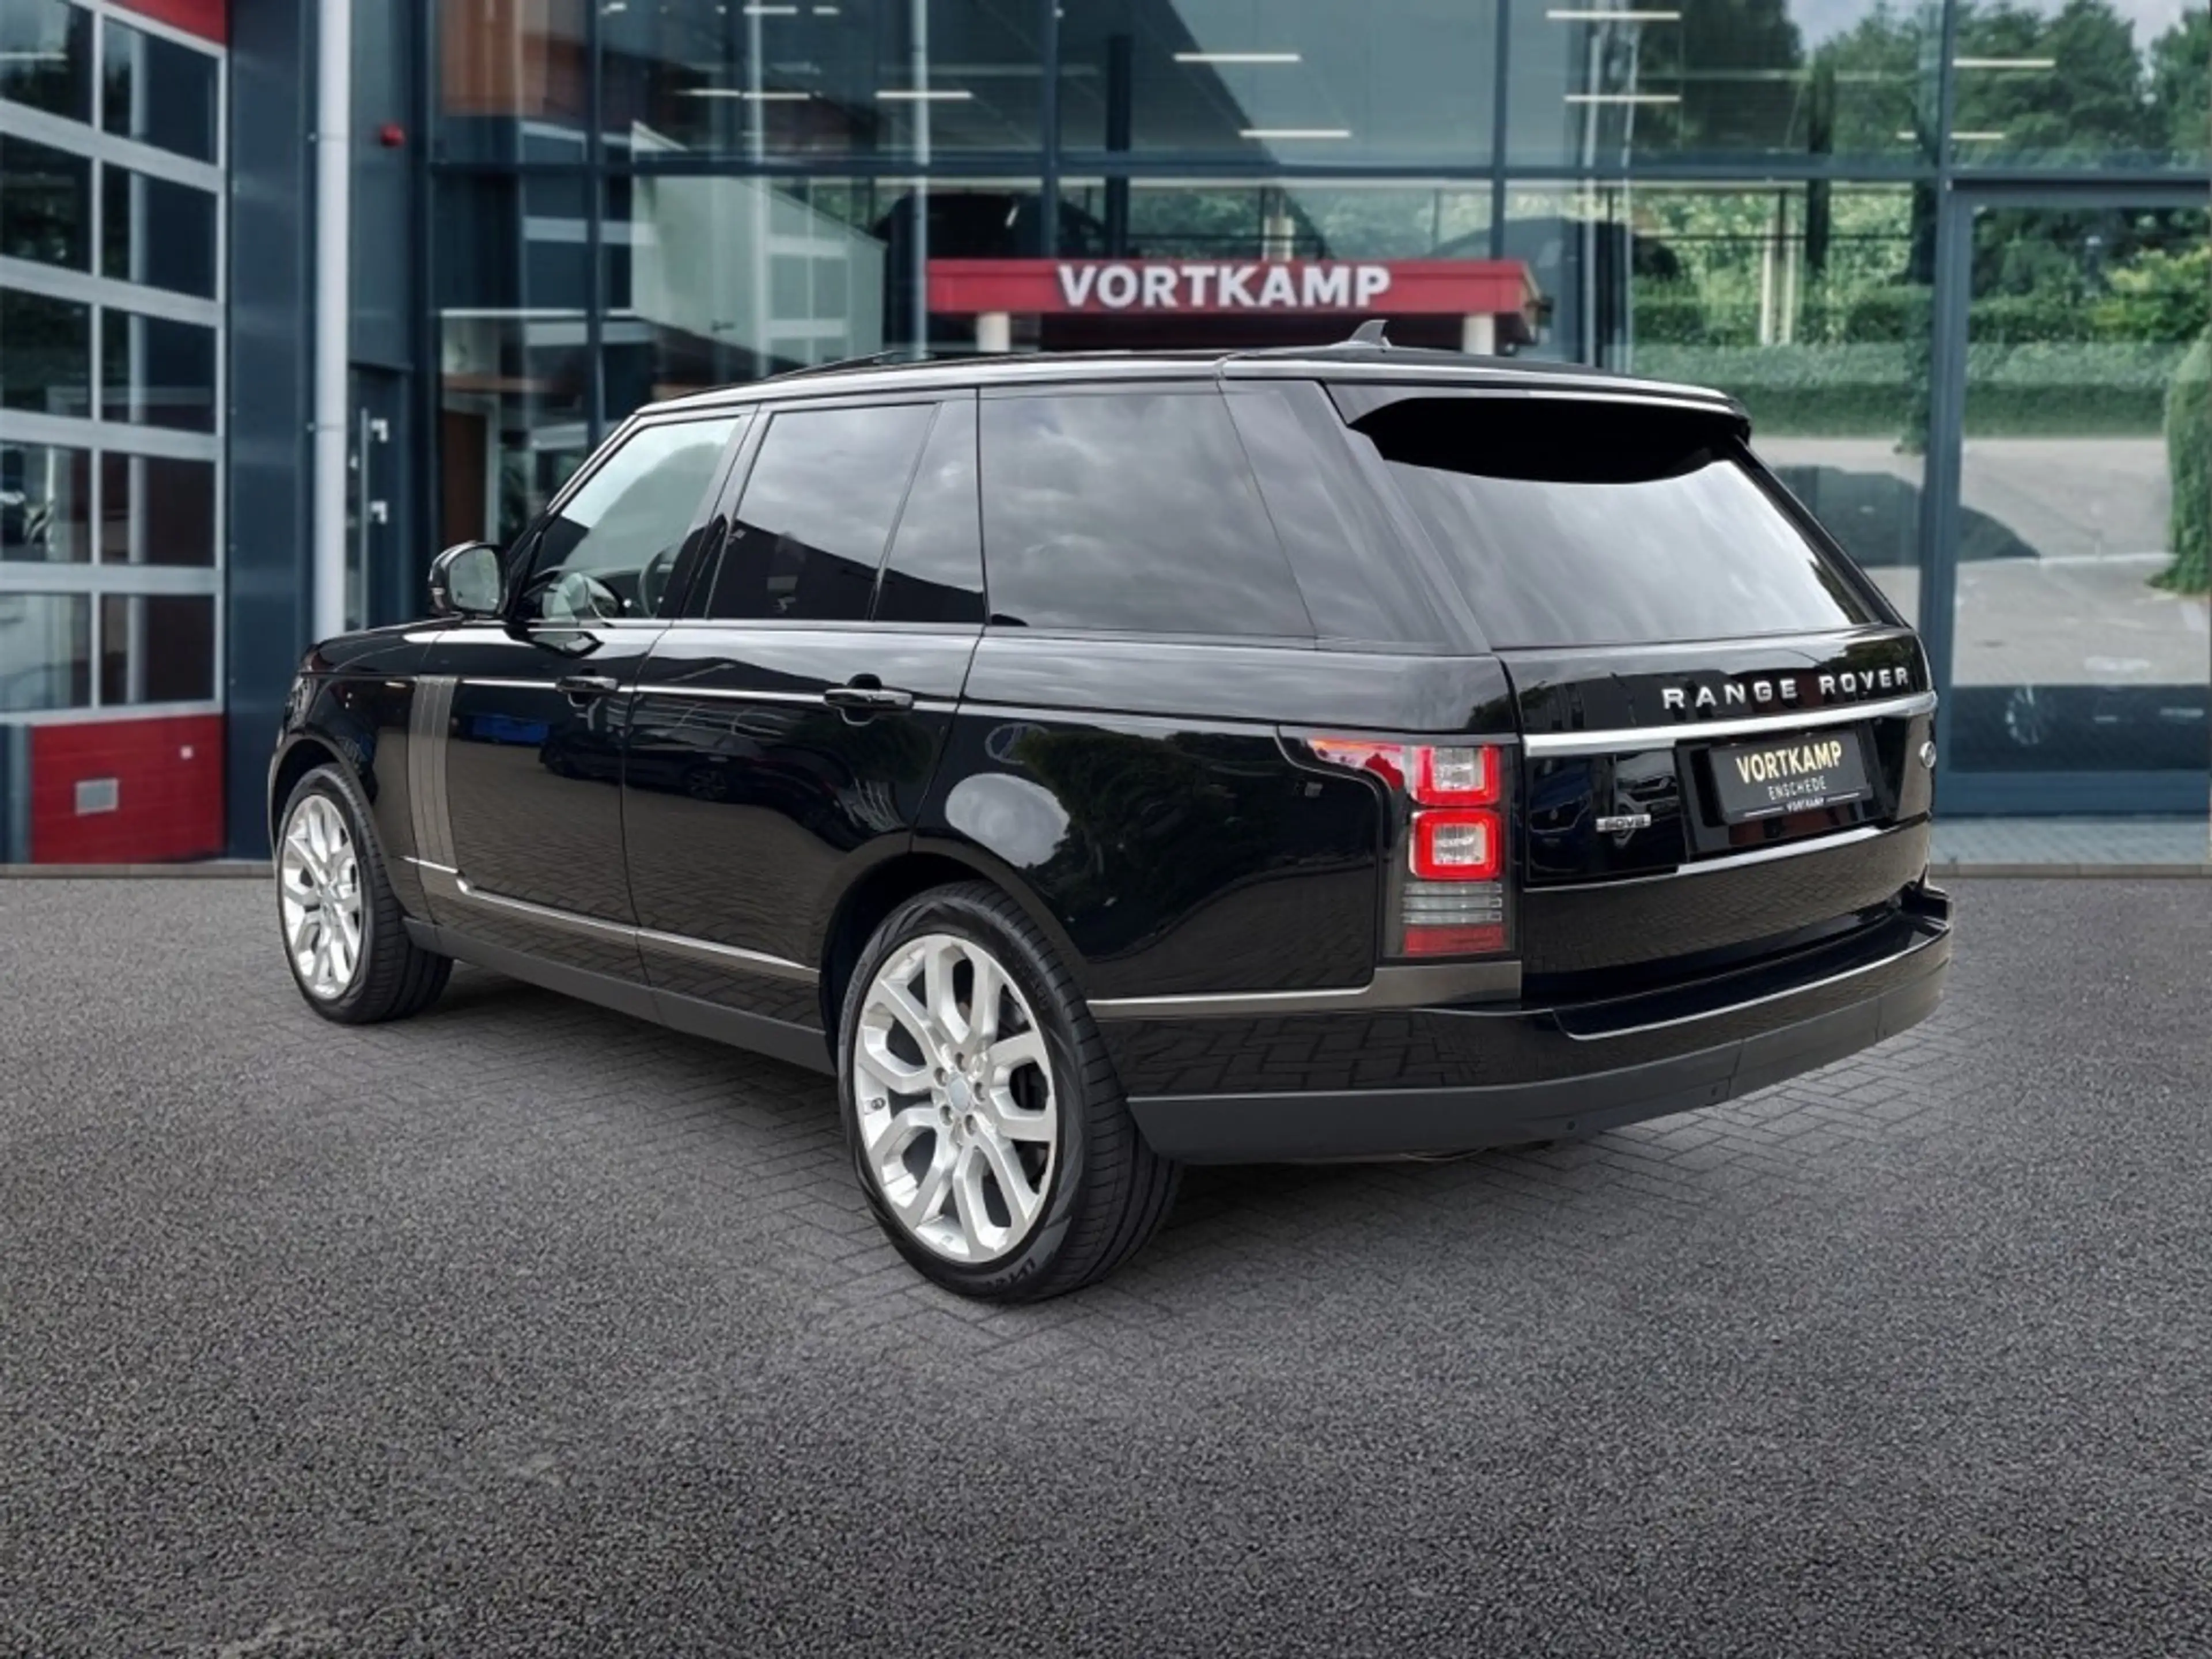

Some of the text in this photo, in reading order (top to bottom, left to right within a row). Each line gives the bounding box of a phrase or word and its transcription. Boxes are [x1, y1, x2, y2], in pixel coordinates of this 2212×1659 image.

[1058, 264, 1390, 308] VORTKAMP
[1662, 666, 1908, 710] RANGE ROVER
[1735, 740, 1842, 785] VORTKAMP
[1768, 775, 1827, 801] ENSCHEDE
